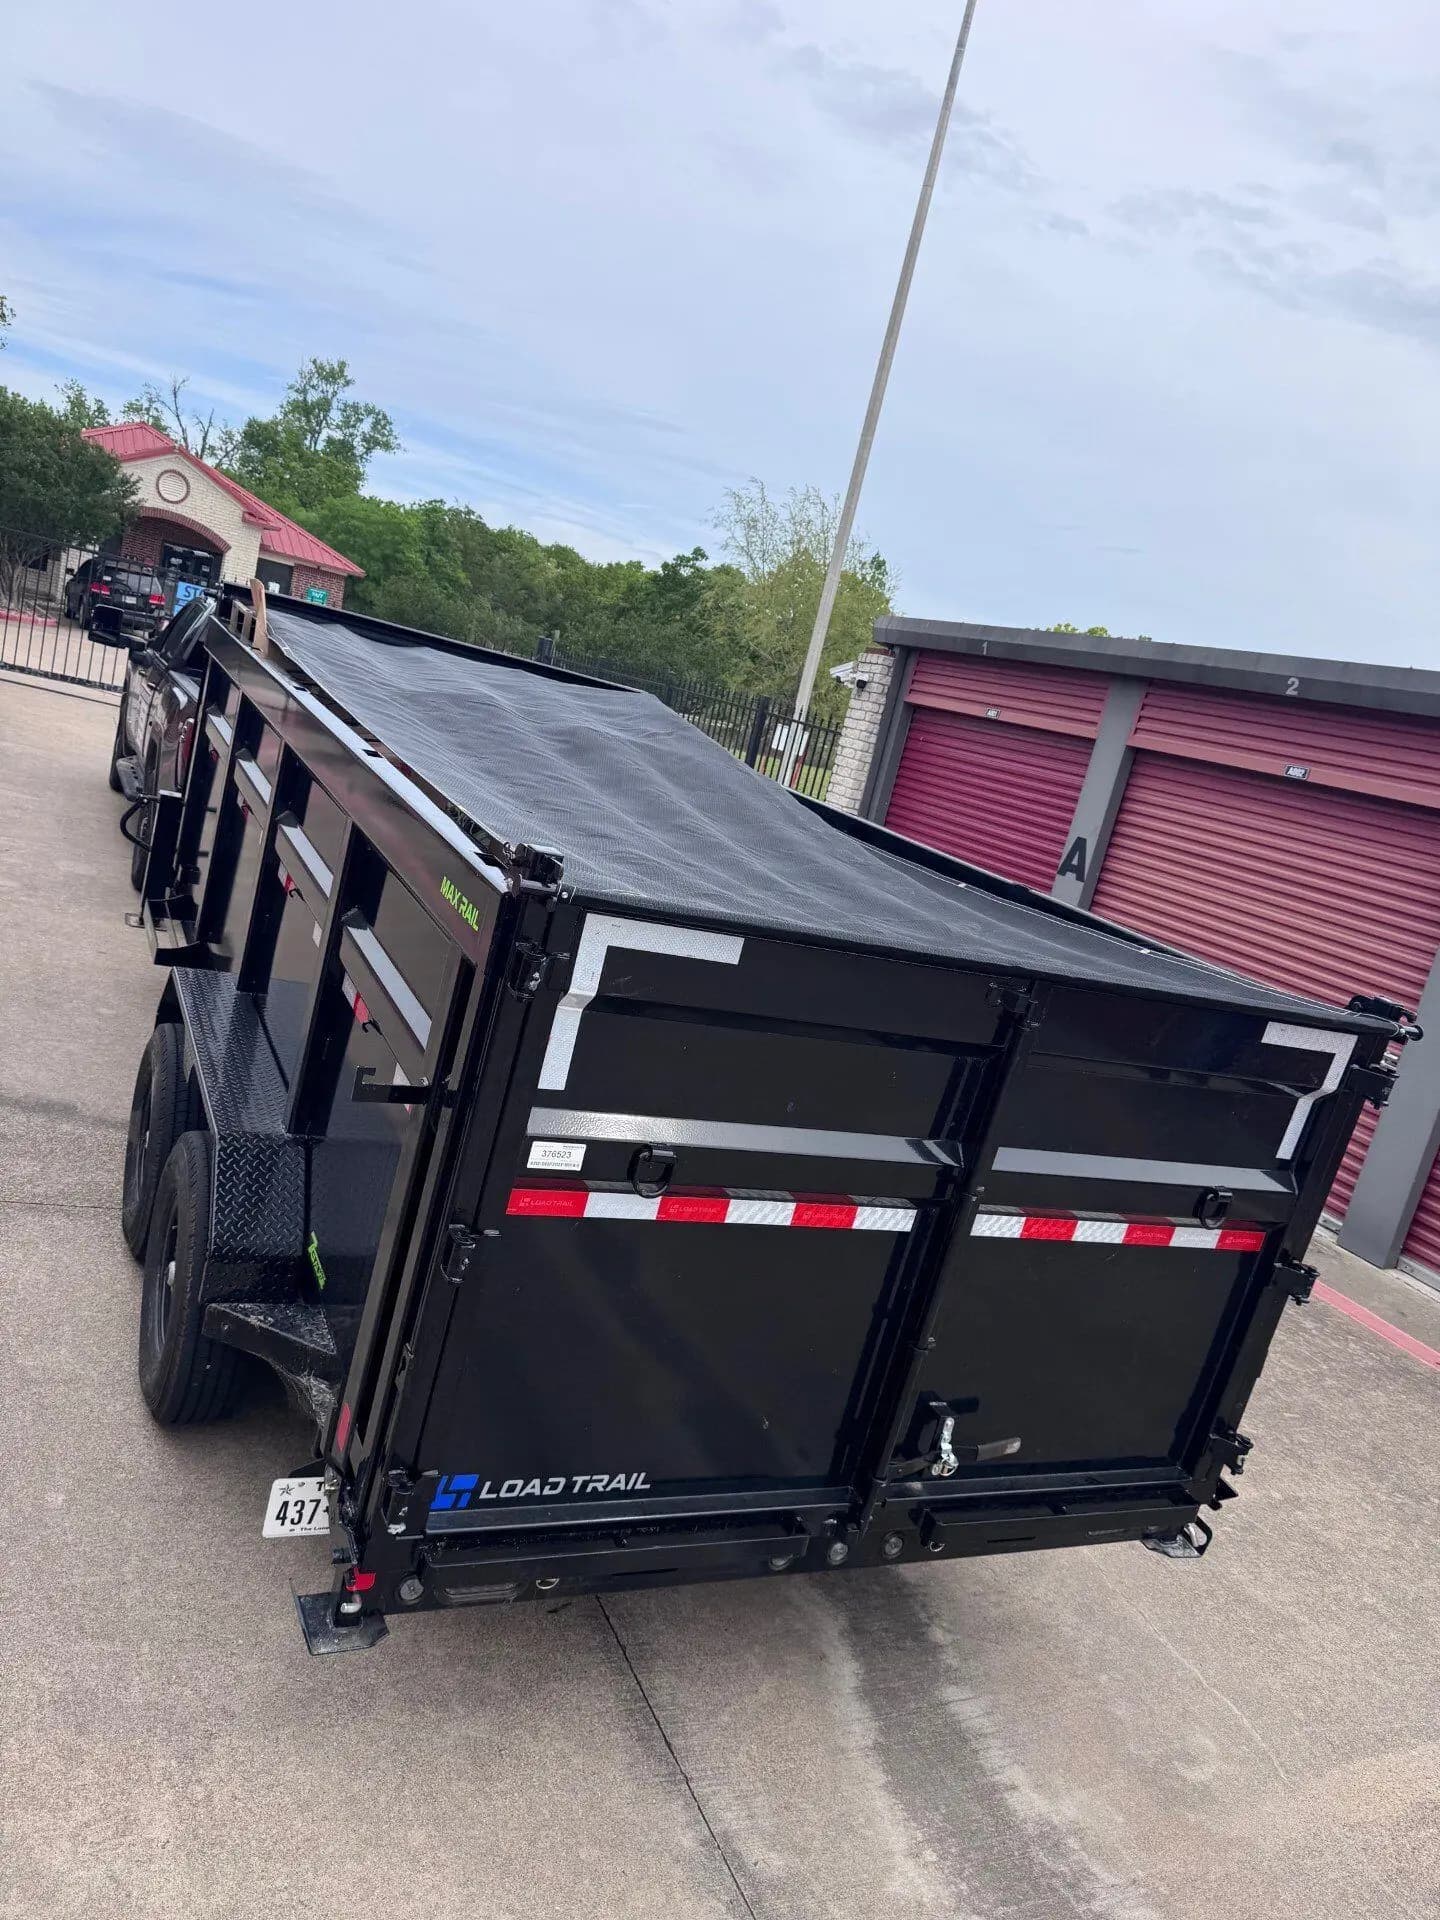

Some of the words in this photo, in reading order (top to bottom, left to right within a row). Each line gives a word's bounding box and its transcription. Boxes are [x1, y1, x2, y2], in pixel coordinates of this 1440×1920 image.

[982, 640, 988, 655] 1
[1285, 676, 1300, 695] 2
[1057, 836, 1087, 882] A
[440, 875, 461, 910] MAX
[458, 895, 479, 931] RAIL
[541, 1149, 572, 1159] 376523
[478, 1477, 566, 1500] LOAD
[571, 1472, 651, 1494] TRAIL
